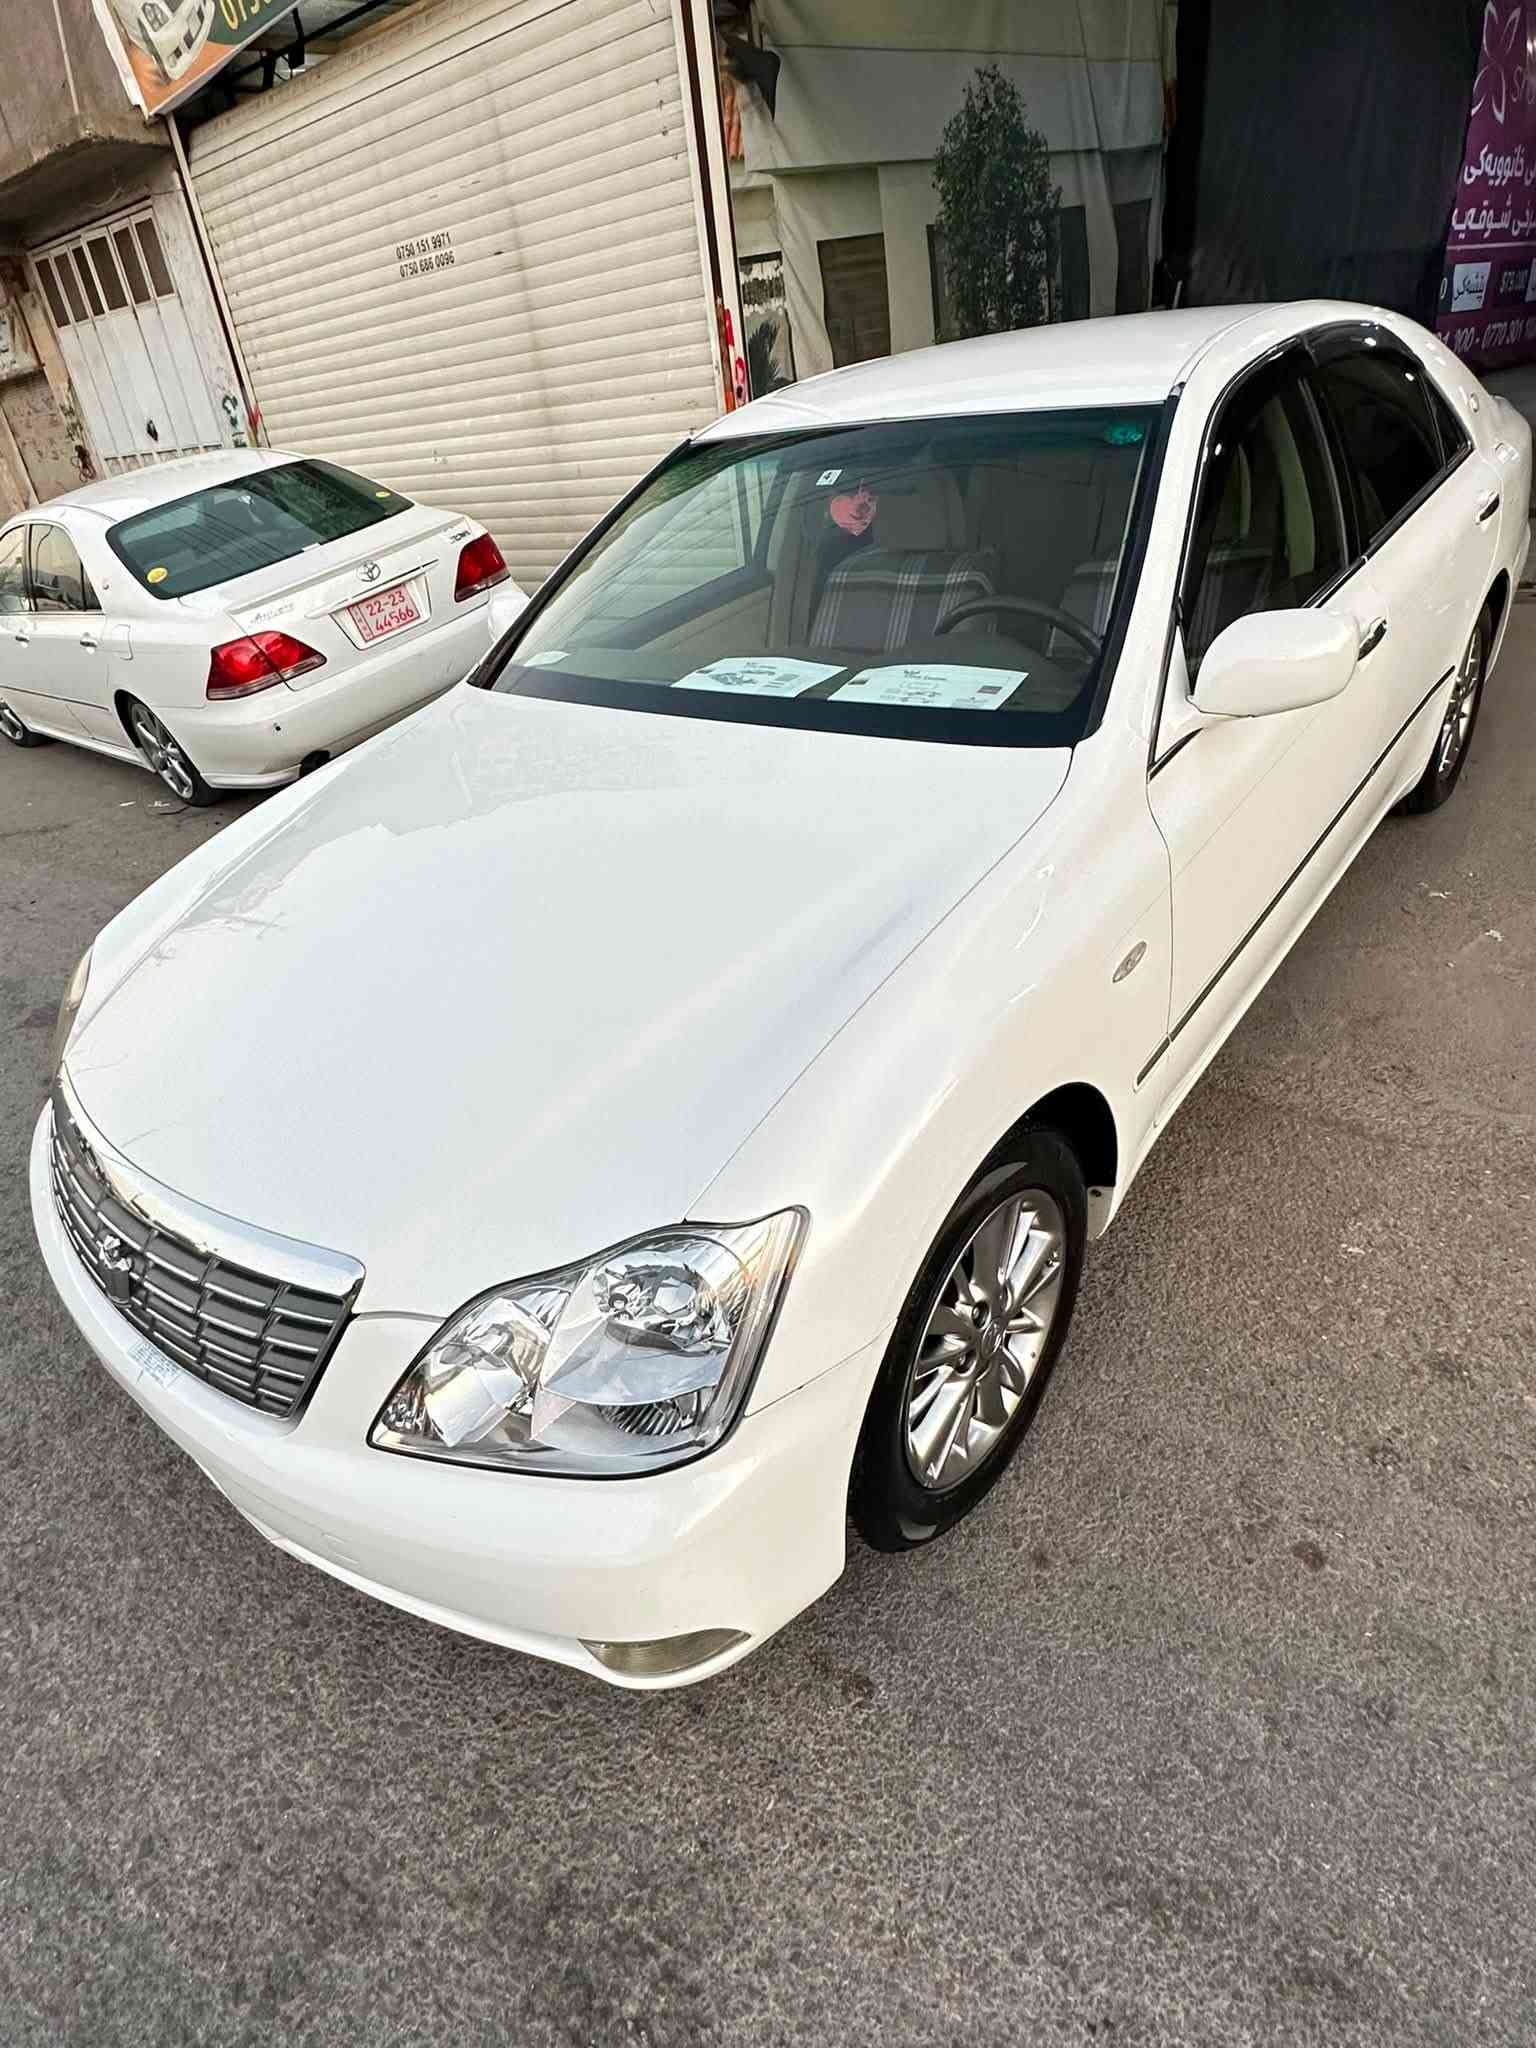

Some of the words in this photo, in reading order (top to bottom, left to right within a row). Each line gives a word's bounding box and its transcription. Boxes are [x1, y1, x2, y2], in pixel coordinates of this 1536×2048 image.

[396, 242, 415, 260] 0750
[416, 238, 430, 254] 151
[400, 260, 418, 278] 0750
[435, 250, 455, 268] 0096
[366, 590, 406, 617] 22-23
[375, 604, 415, 632] 44566
